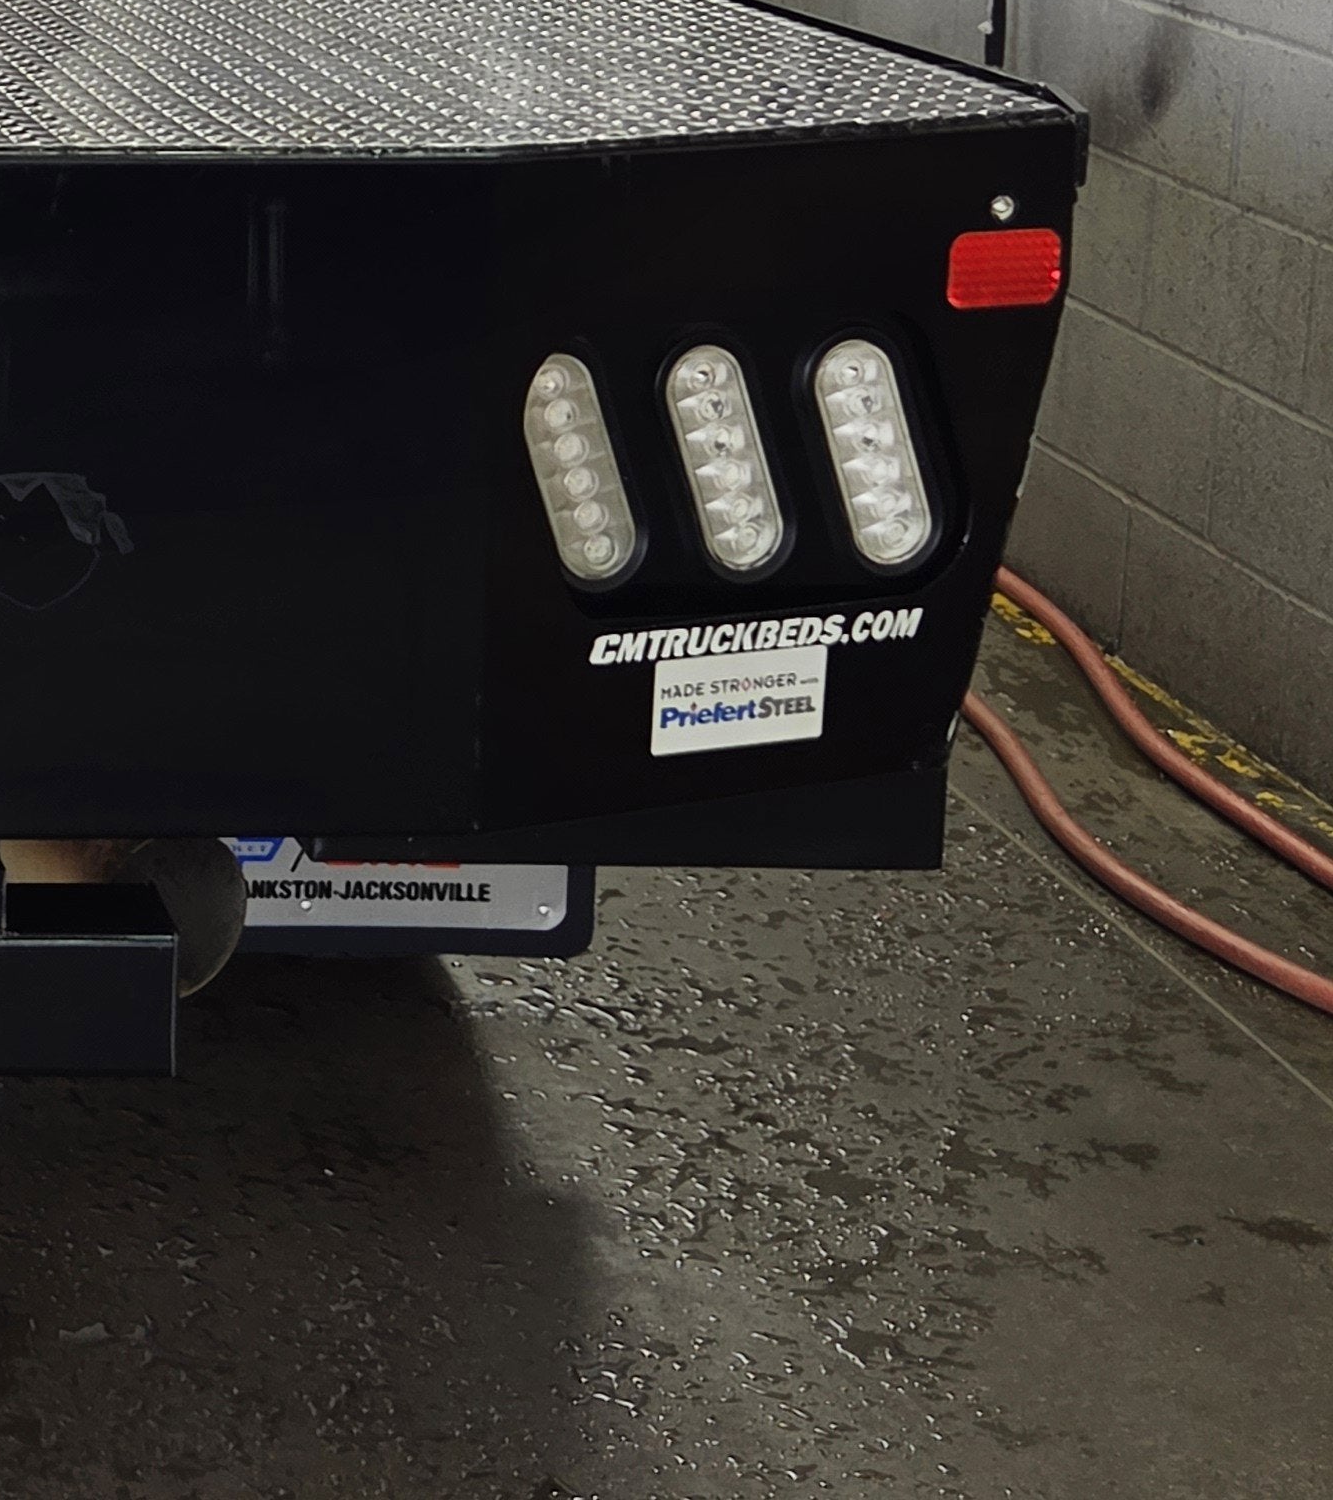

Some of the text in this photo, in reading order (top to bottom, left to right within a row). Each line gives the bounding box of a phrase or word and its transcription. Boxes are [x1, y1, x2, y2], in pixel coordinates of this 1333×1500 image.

[588, 607, 924, 665] CMTRUCKBEDS.COM
[660, 681, 705, 700] MADE
[709, 672, 798, 695] STRONGER
